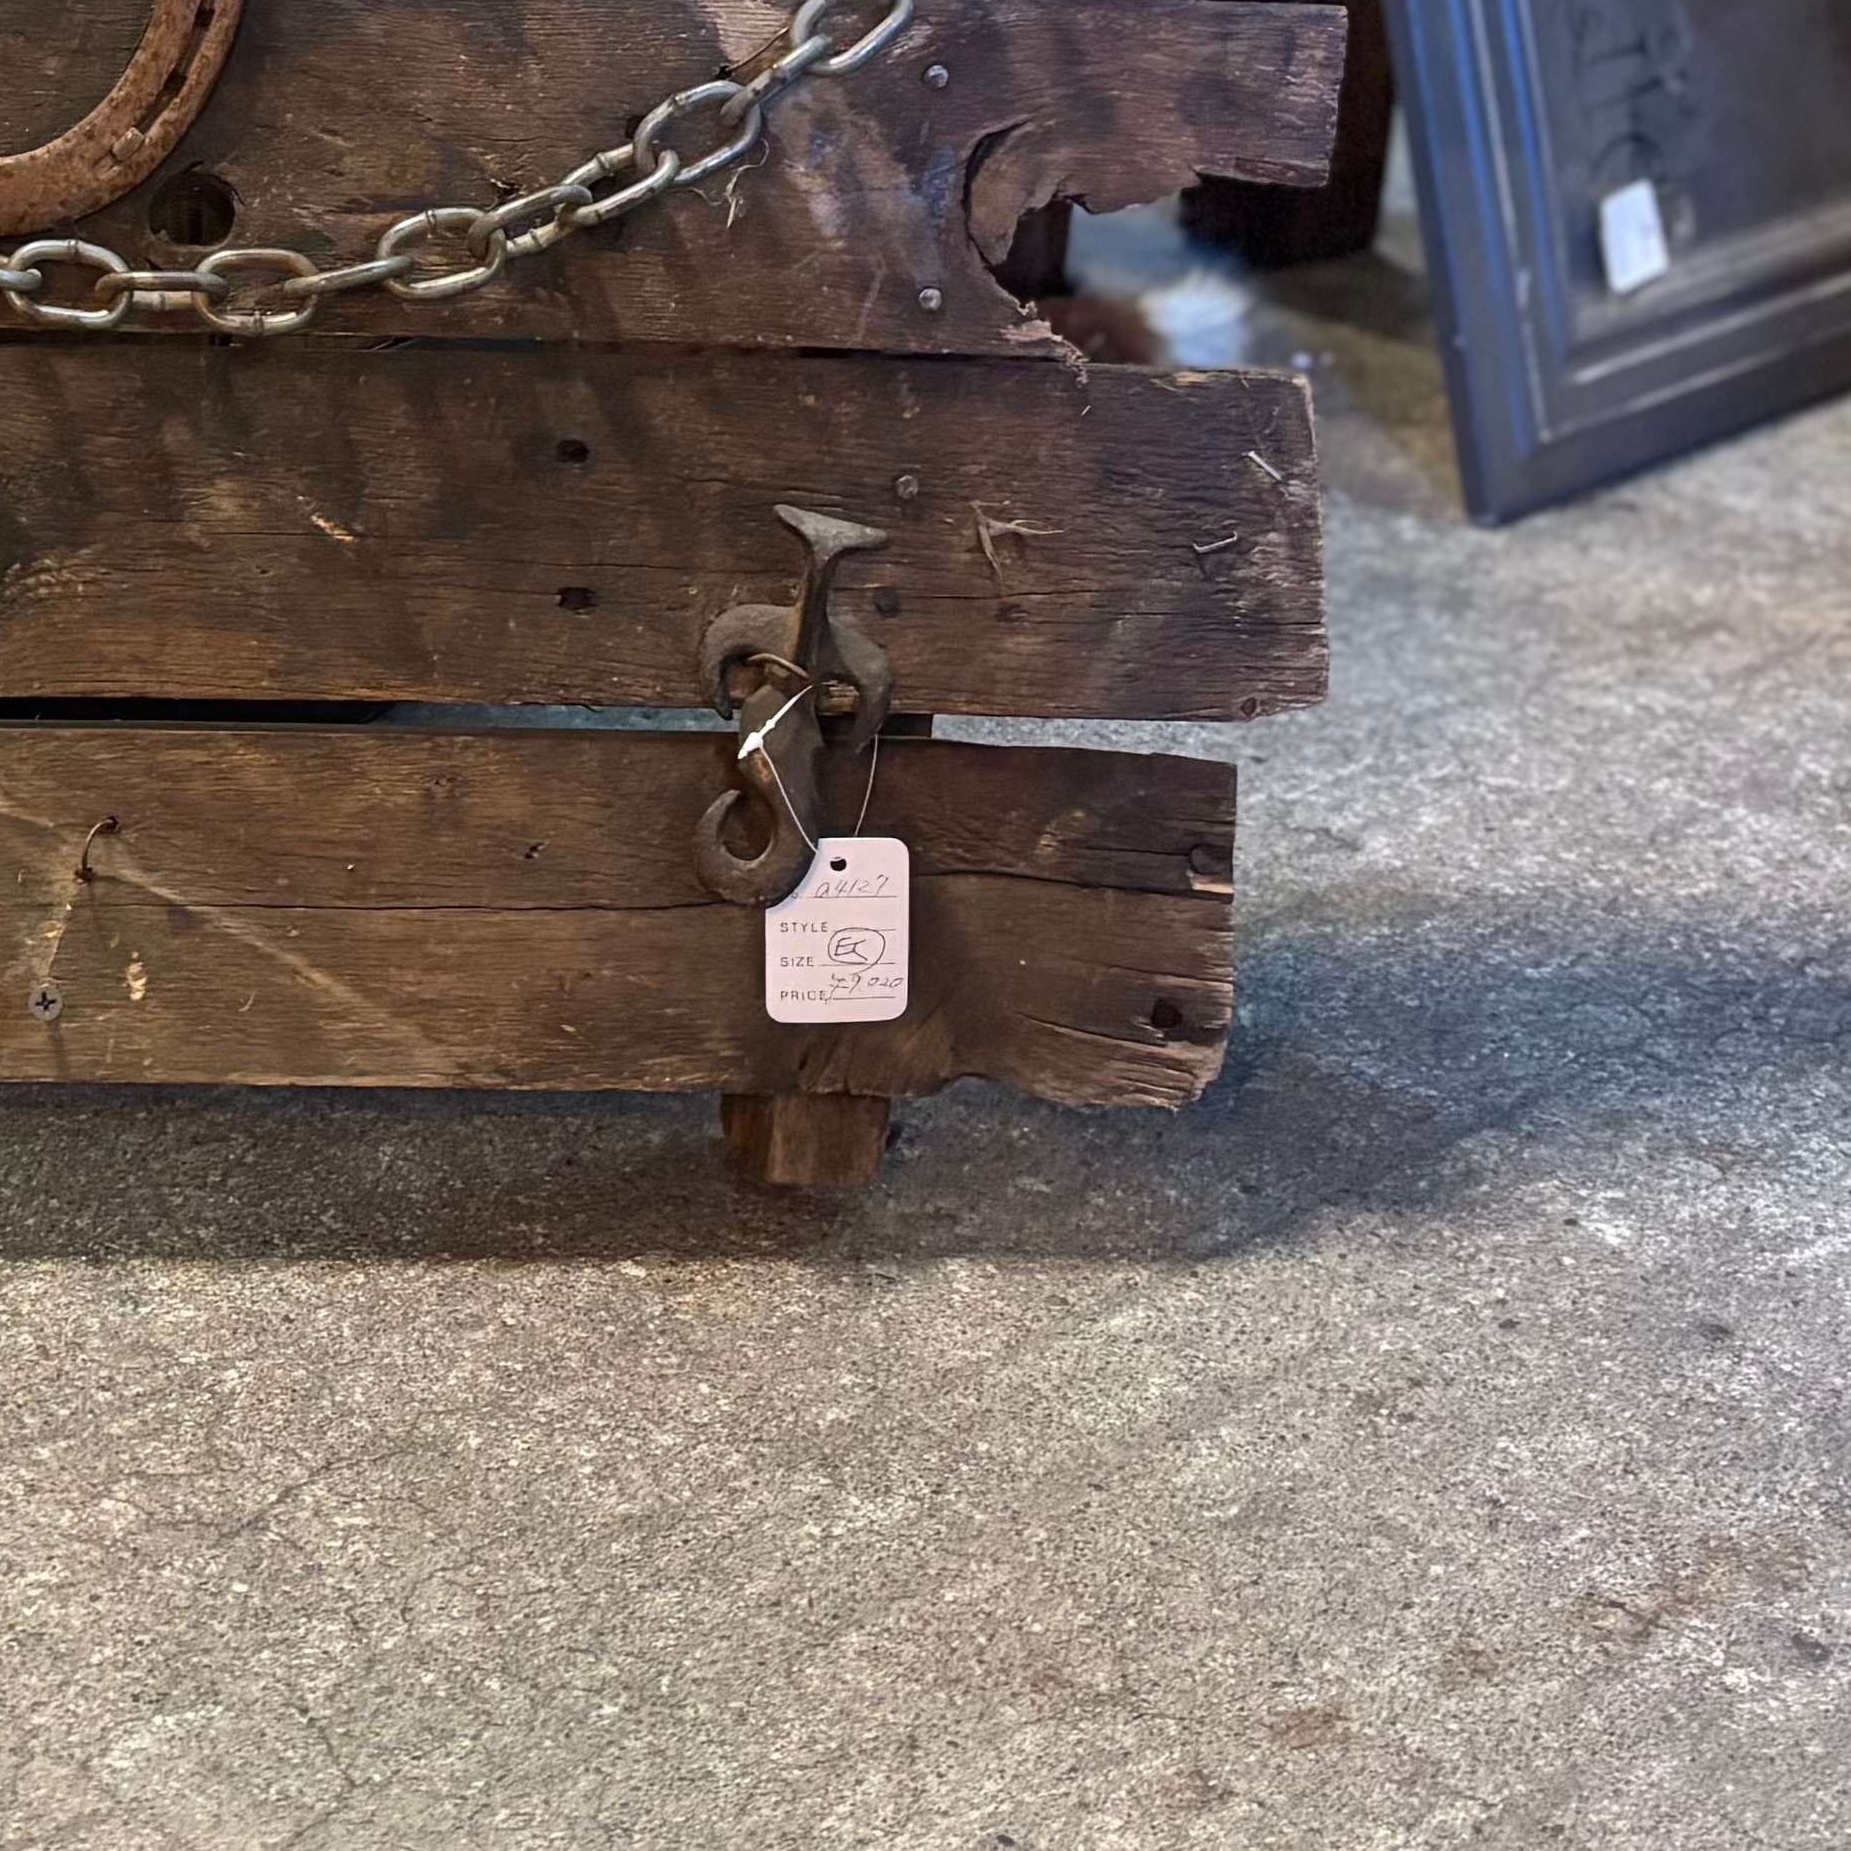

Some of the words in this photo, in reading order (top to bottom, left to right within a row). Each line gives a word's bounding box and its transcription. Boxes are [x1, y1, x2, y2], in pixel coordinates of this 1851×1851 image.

[779, 921, 829, 934] STYLE
[779, 956, 814, 968] SIZE
[779, 990, 827, 1002] PRICE
